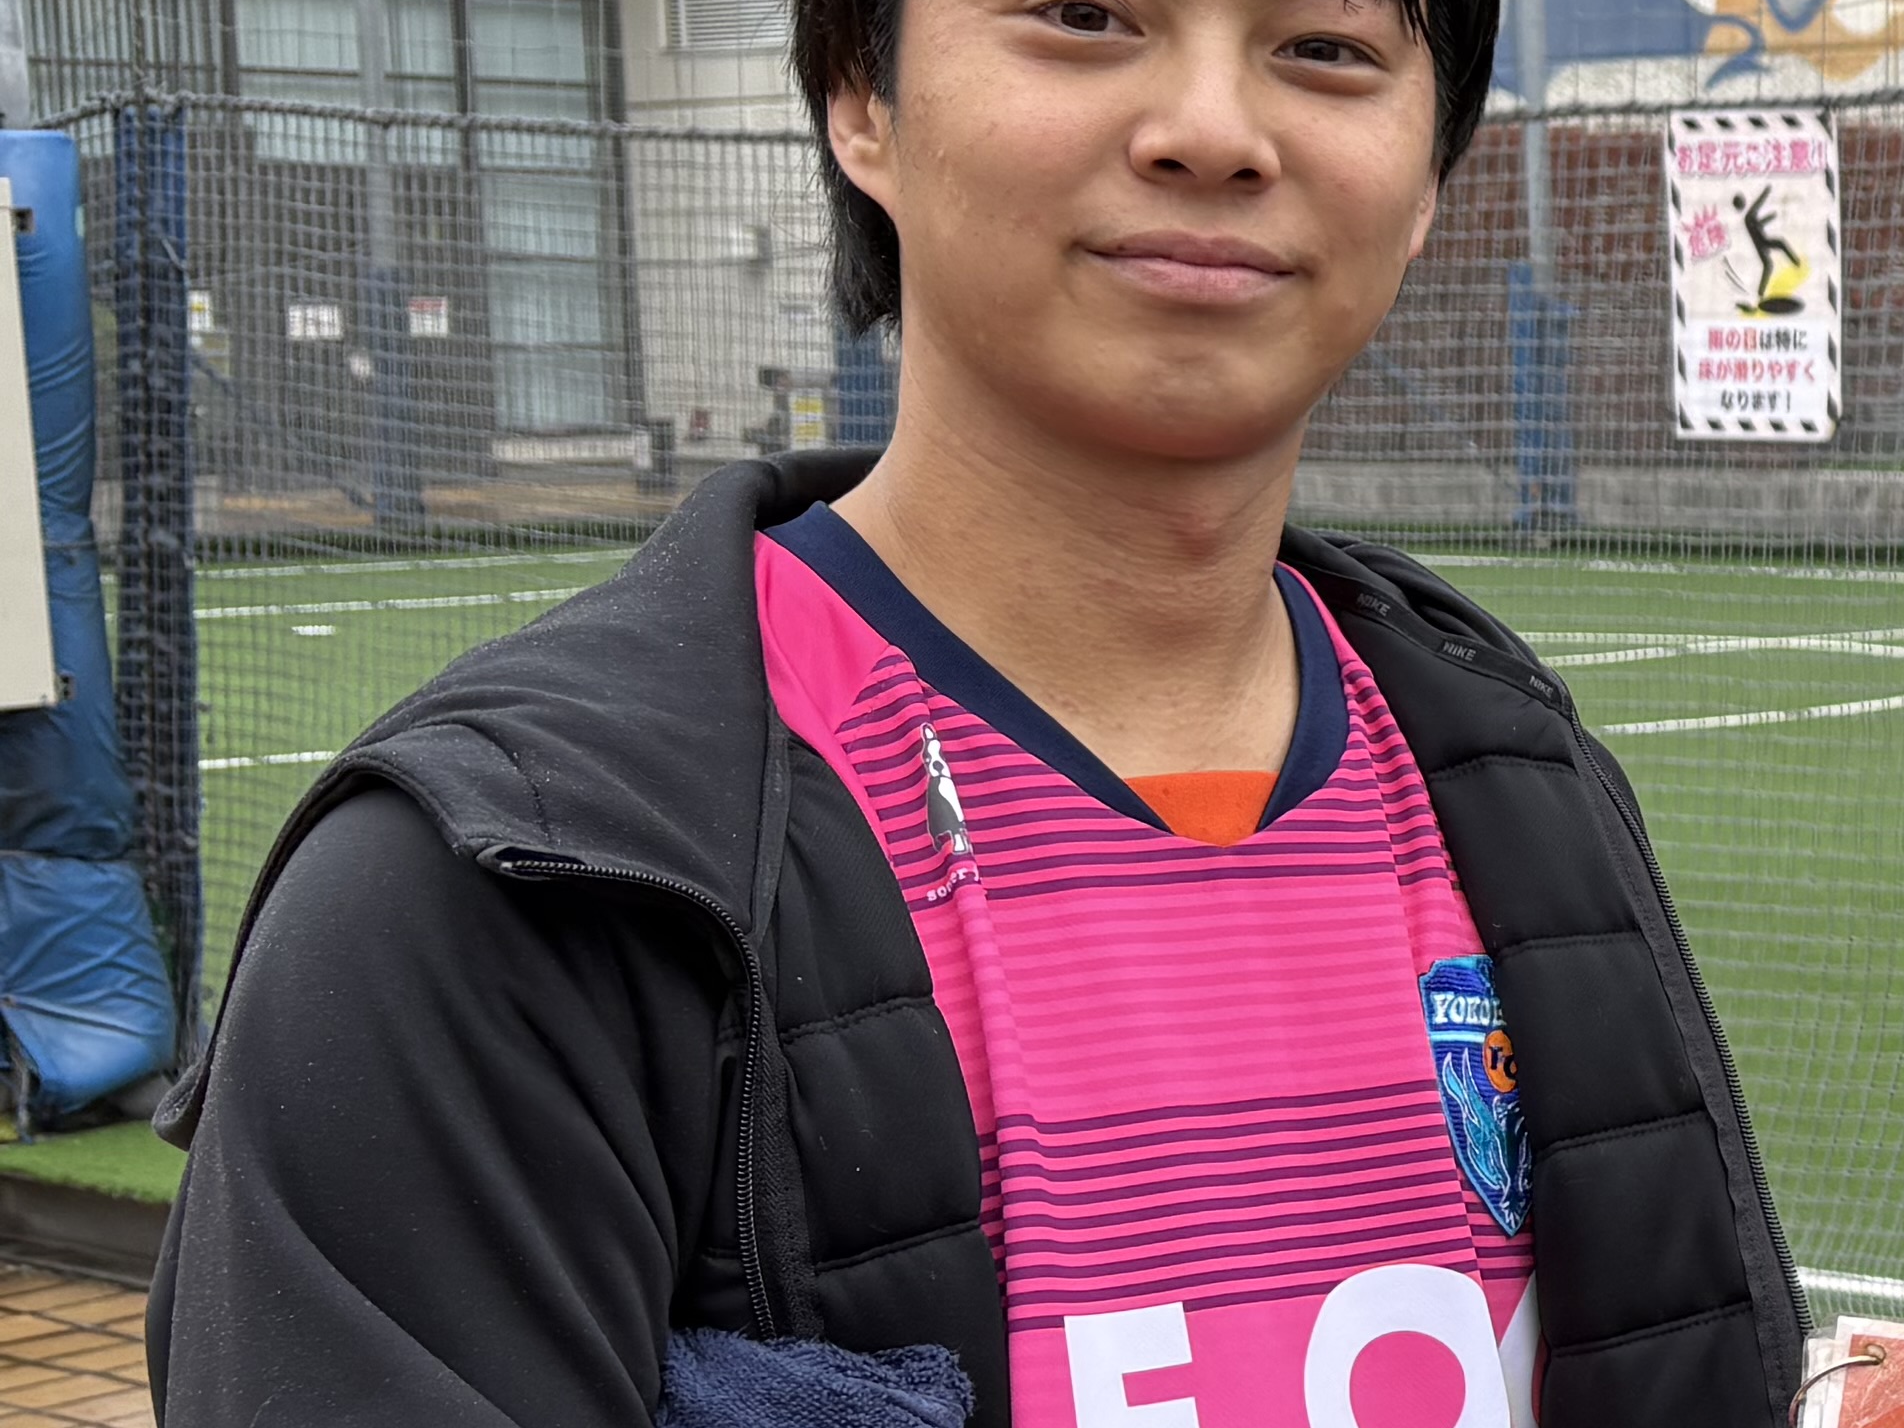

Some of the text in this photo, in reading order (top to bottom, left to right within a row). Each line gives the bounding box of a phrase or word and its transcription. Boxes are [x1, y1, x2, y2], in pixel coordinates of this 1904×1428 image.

[1708, 327, 1808, 352] 雨の日は特に
[1698, 358, 1816, 384] 床が滑りやすく
[1356, 592, 1391, 618] NIKE
[1442, 639, 1478, 662] NIKE
[1529, 674, 1555, 698] NIKE
